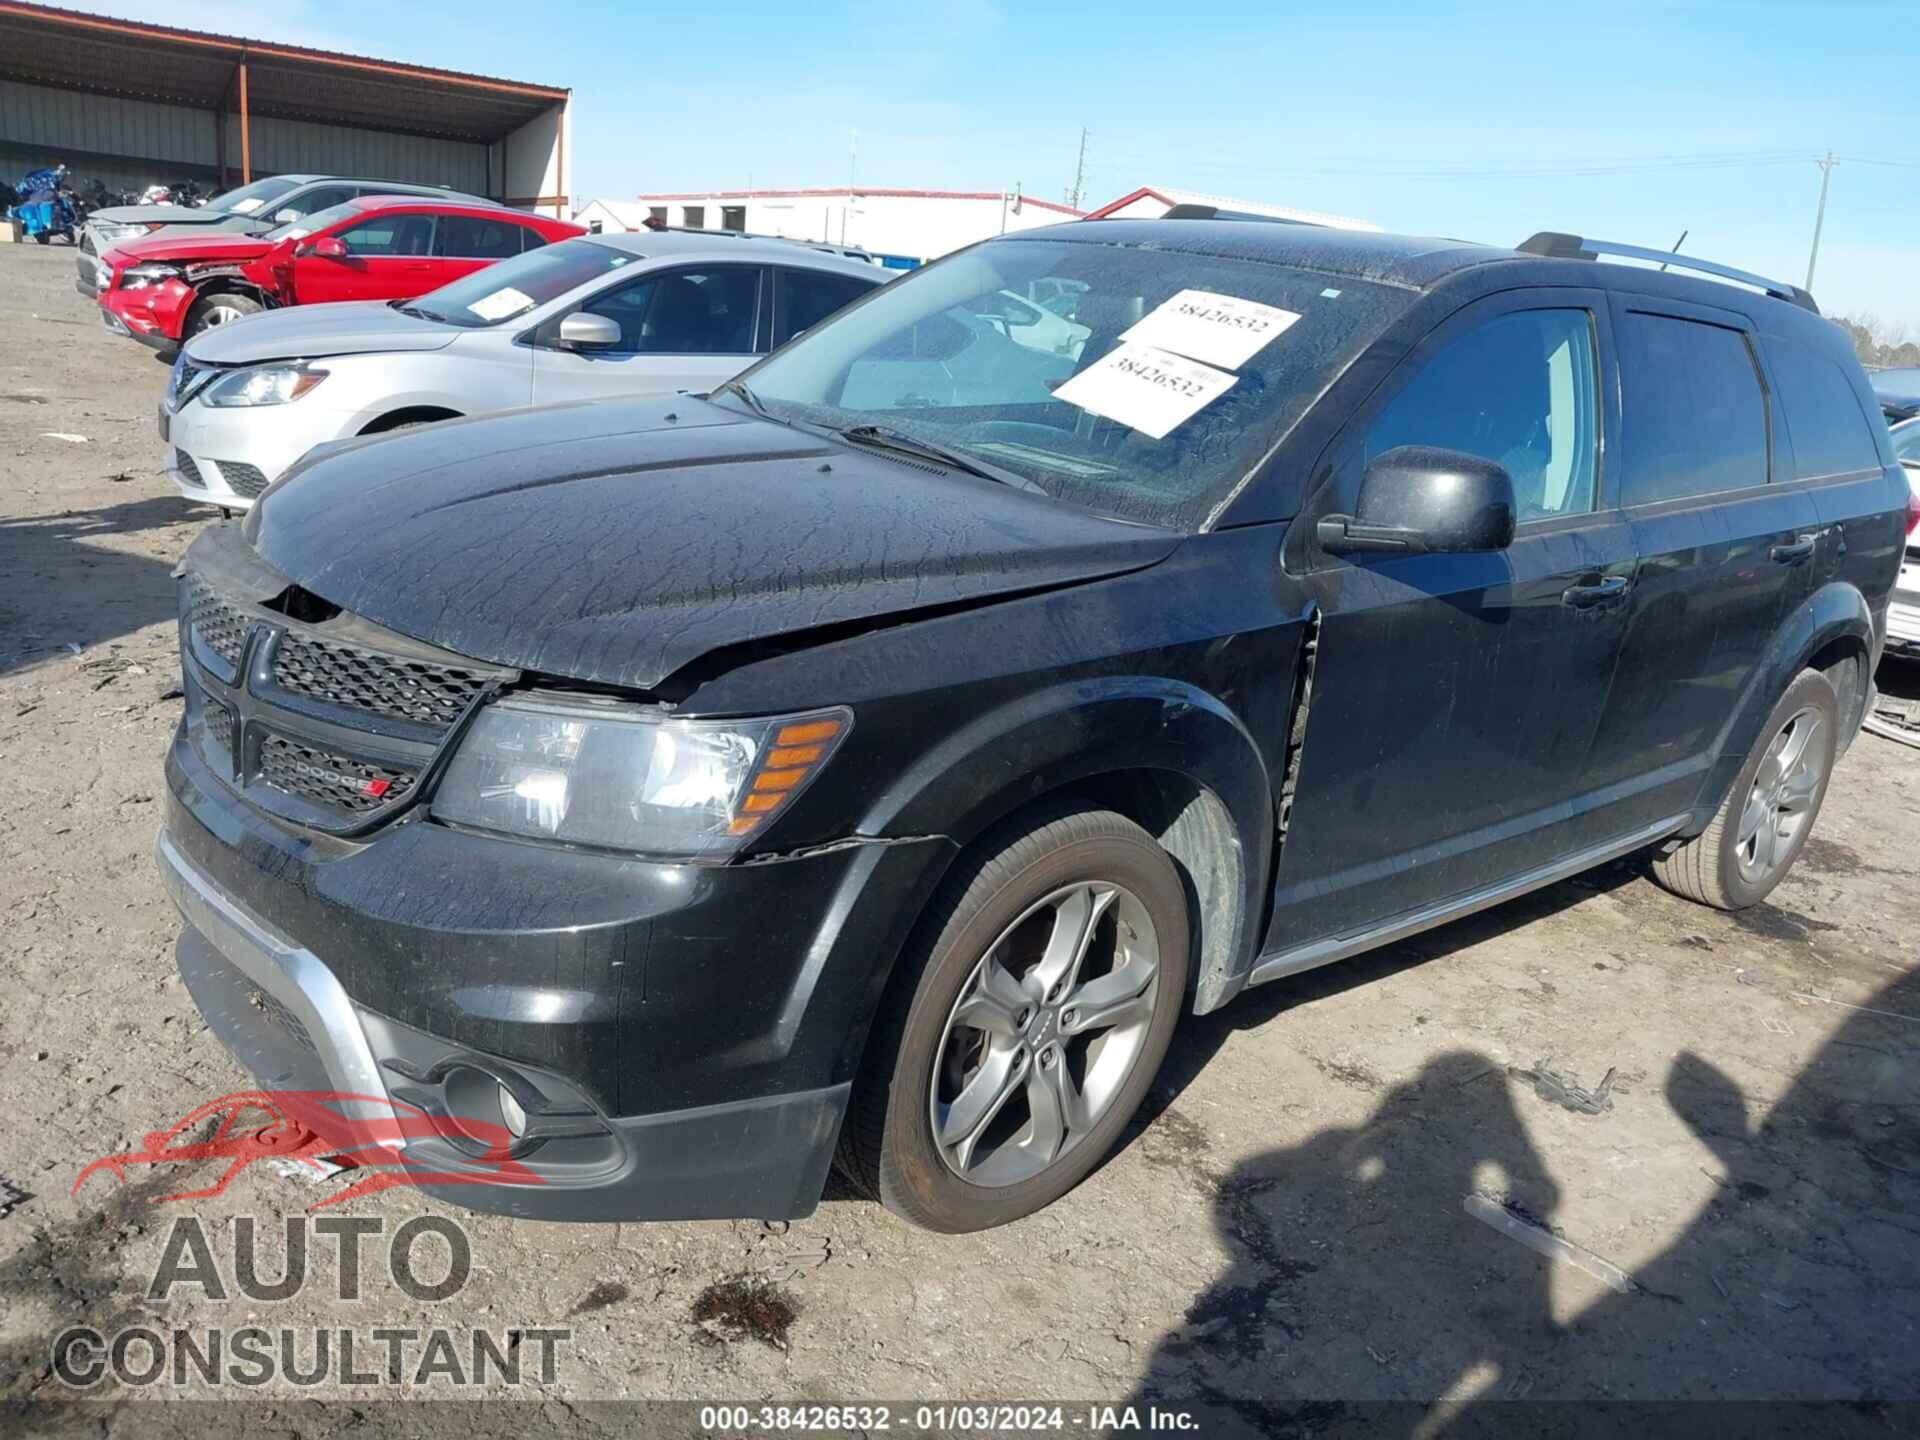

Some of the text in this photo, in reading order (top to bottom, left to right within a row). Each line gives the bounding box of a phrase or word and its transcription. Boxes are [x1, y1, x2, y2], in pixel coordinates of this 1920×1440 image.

[1173, 302, 1269, 333] 38426532
[1110, 357, 1204, 397] 38426532
[297, 761, 369, 790] DODGE
